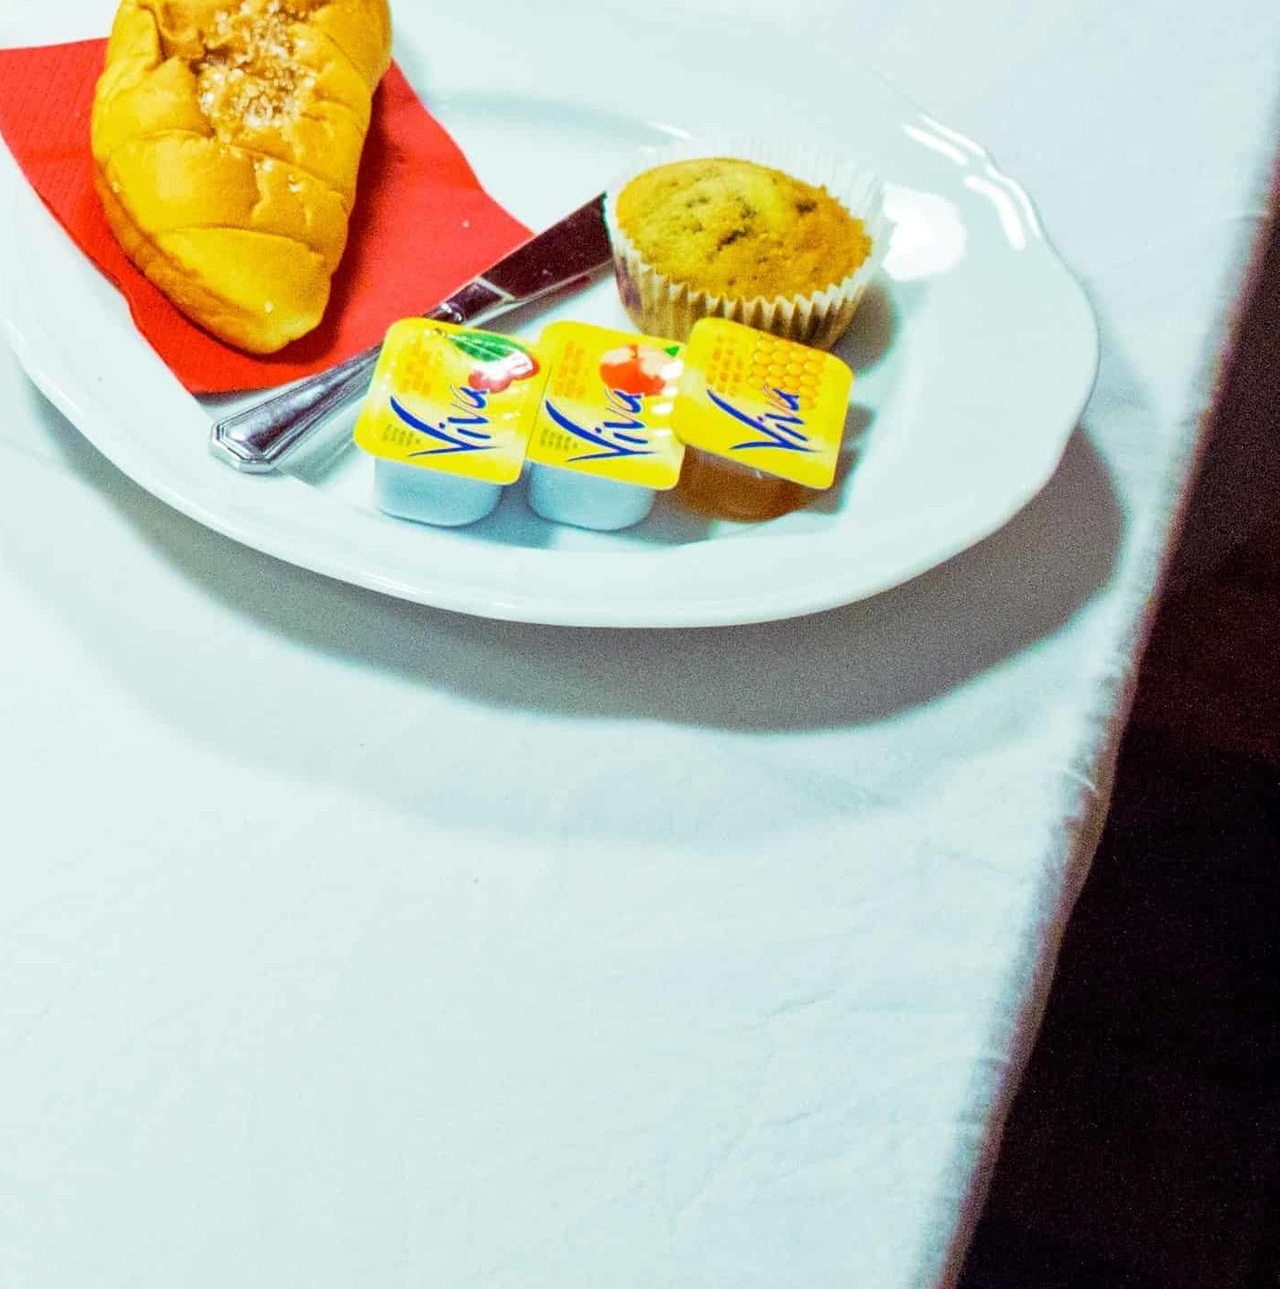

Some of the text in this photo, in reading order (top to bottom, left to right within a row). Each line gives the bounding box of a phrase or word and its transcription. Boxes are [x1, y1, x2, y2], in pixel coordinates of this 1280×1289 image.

[390, 383, 503, 457] Viva
[545, 388, 657, 462] Viva
[706, 383, 822, 453] Viva
